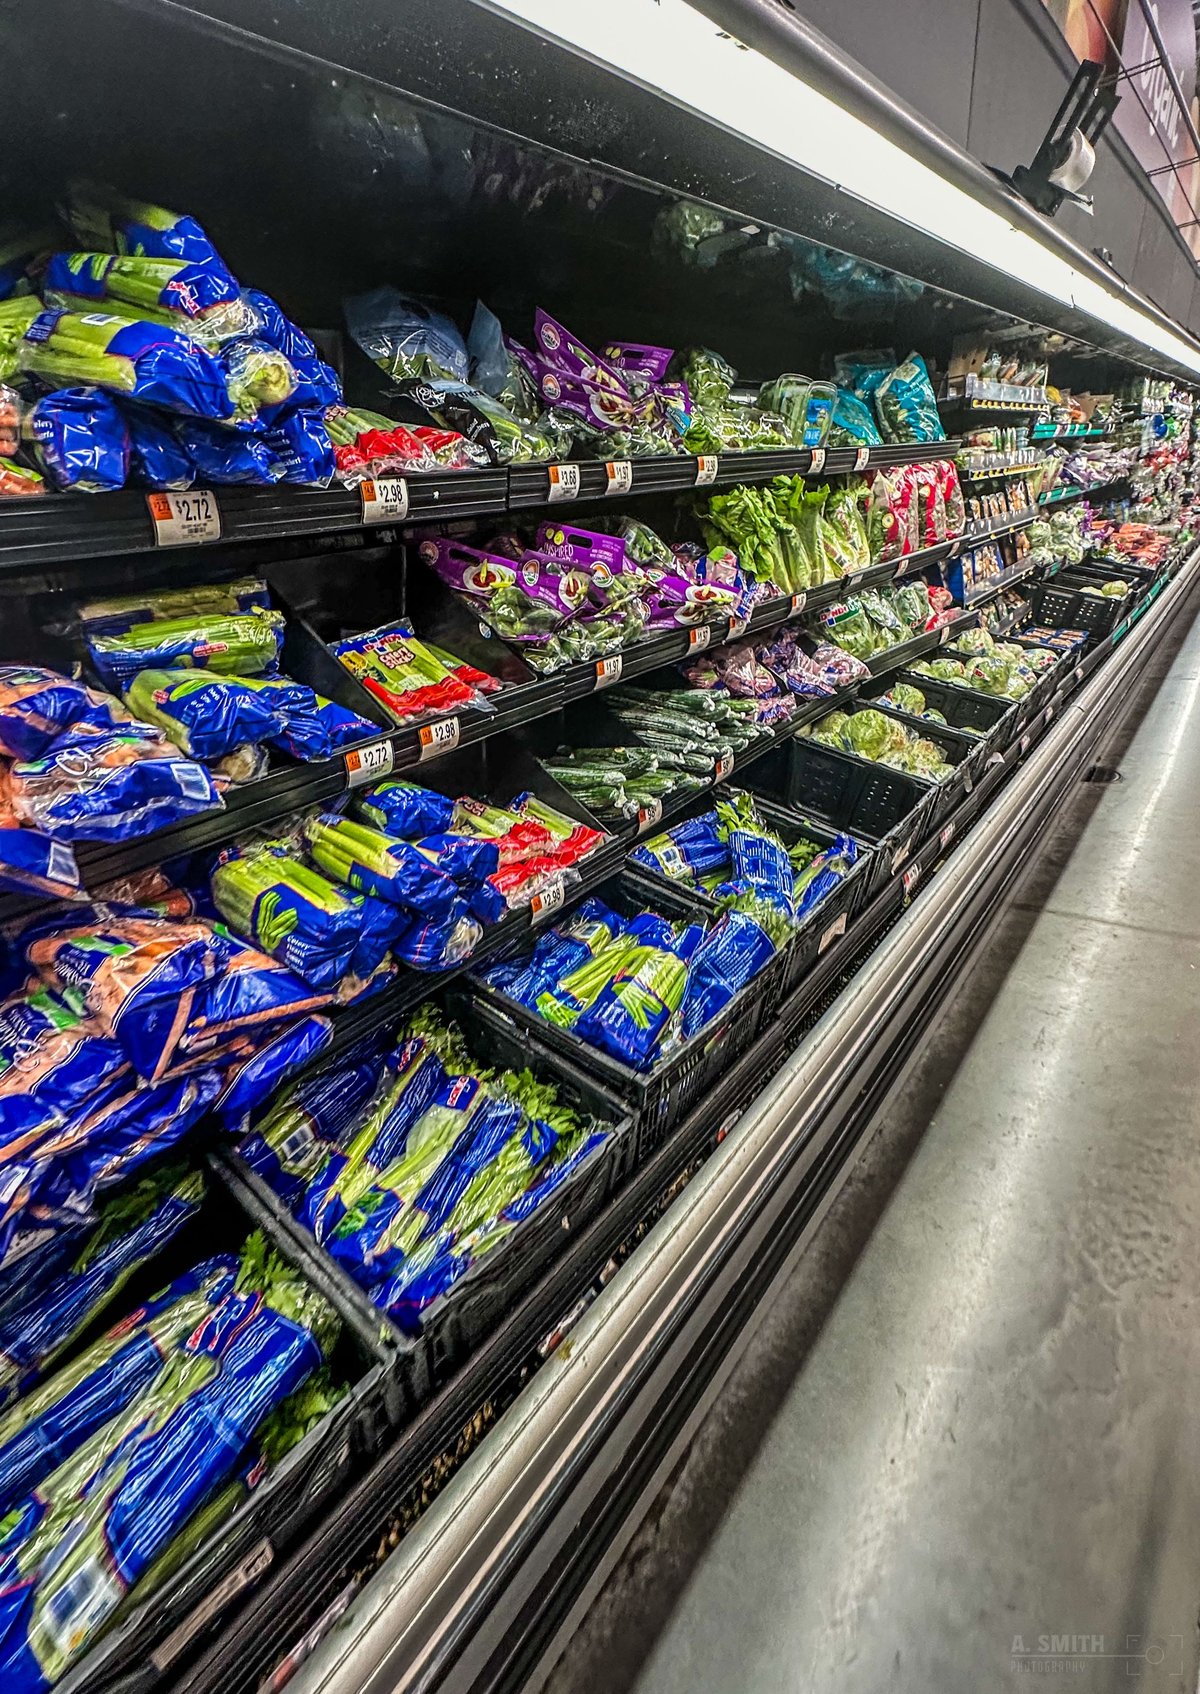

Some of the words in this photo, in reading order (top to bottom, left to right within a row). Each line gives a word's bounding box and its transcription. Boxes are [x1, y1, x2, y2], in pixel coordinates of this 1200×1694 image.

[561, 470, 577, 486] $3.68
[379, 484, 403, 502] $2.98
[176, 499, 211, 521] $2.72
[379, 646, 409, 663] Celery
[386, 653, 414, 669] Sticks
[606, 659, 618, 674] $1.97
[435, 722, 455, 741] $2.98
[364, 746, 388, 767] $2.72
[544, 887, 560, 906] $2.98
